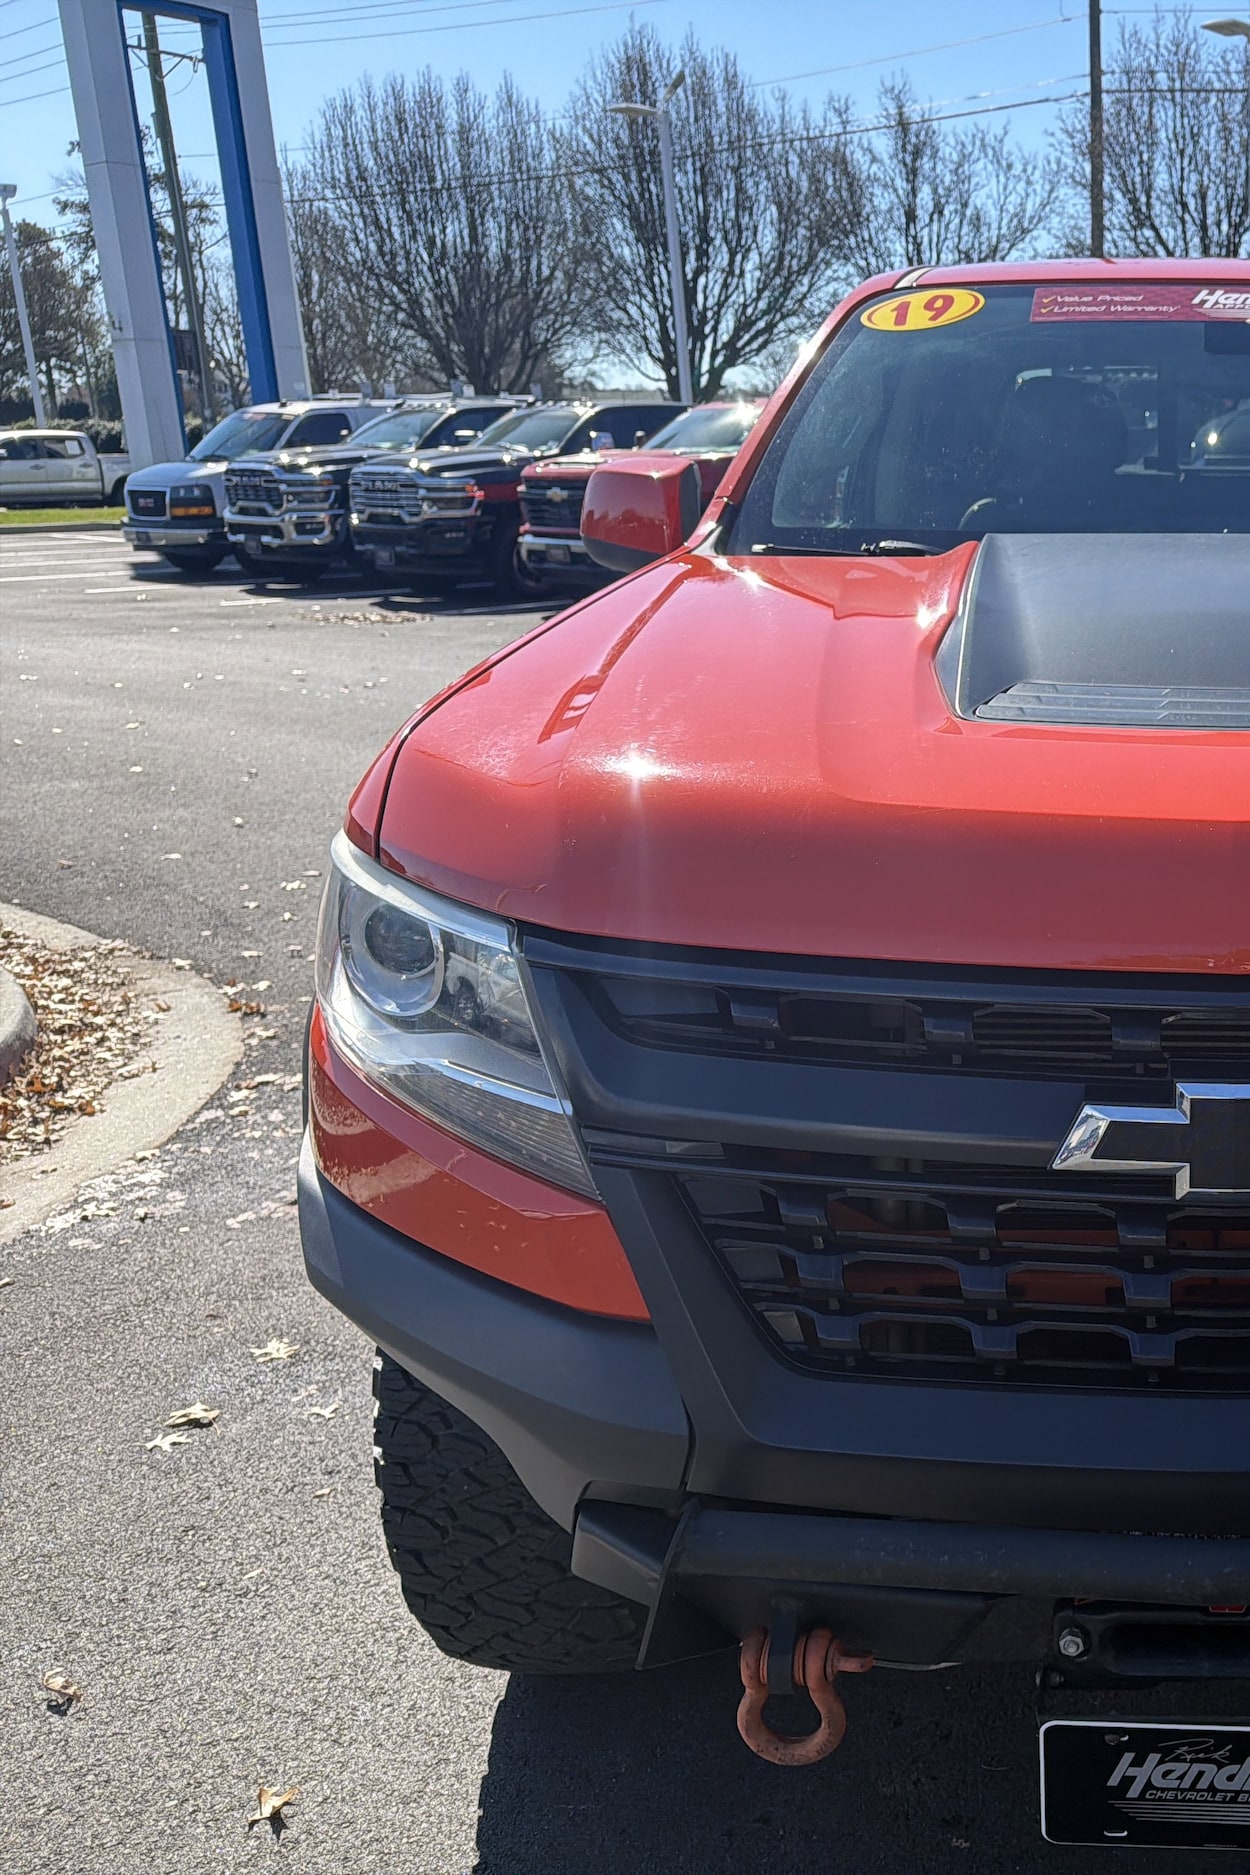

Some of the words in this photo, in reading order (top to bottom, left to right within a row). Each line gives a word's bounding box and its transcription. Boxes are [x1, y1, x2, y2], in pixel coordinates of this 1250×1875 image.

[1056, 295, 1094, 303] Value
[1097, 295, 1144, 303] Priced
[889, 294, 955, 327] 19
[1053, 305, 1107, 313] Limited
[1145, 1789, 1235, 1802] CHEVROLET
